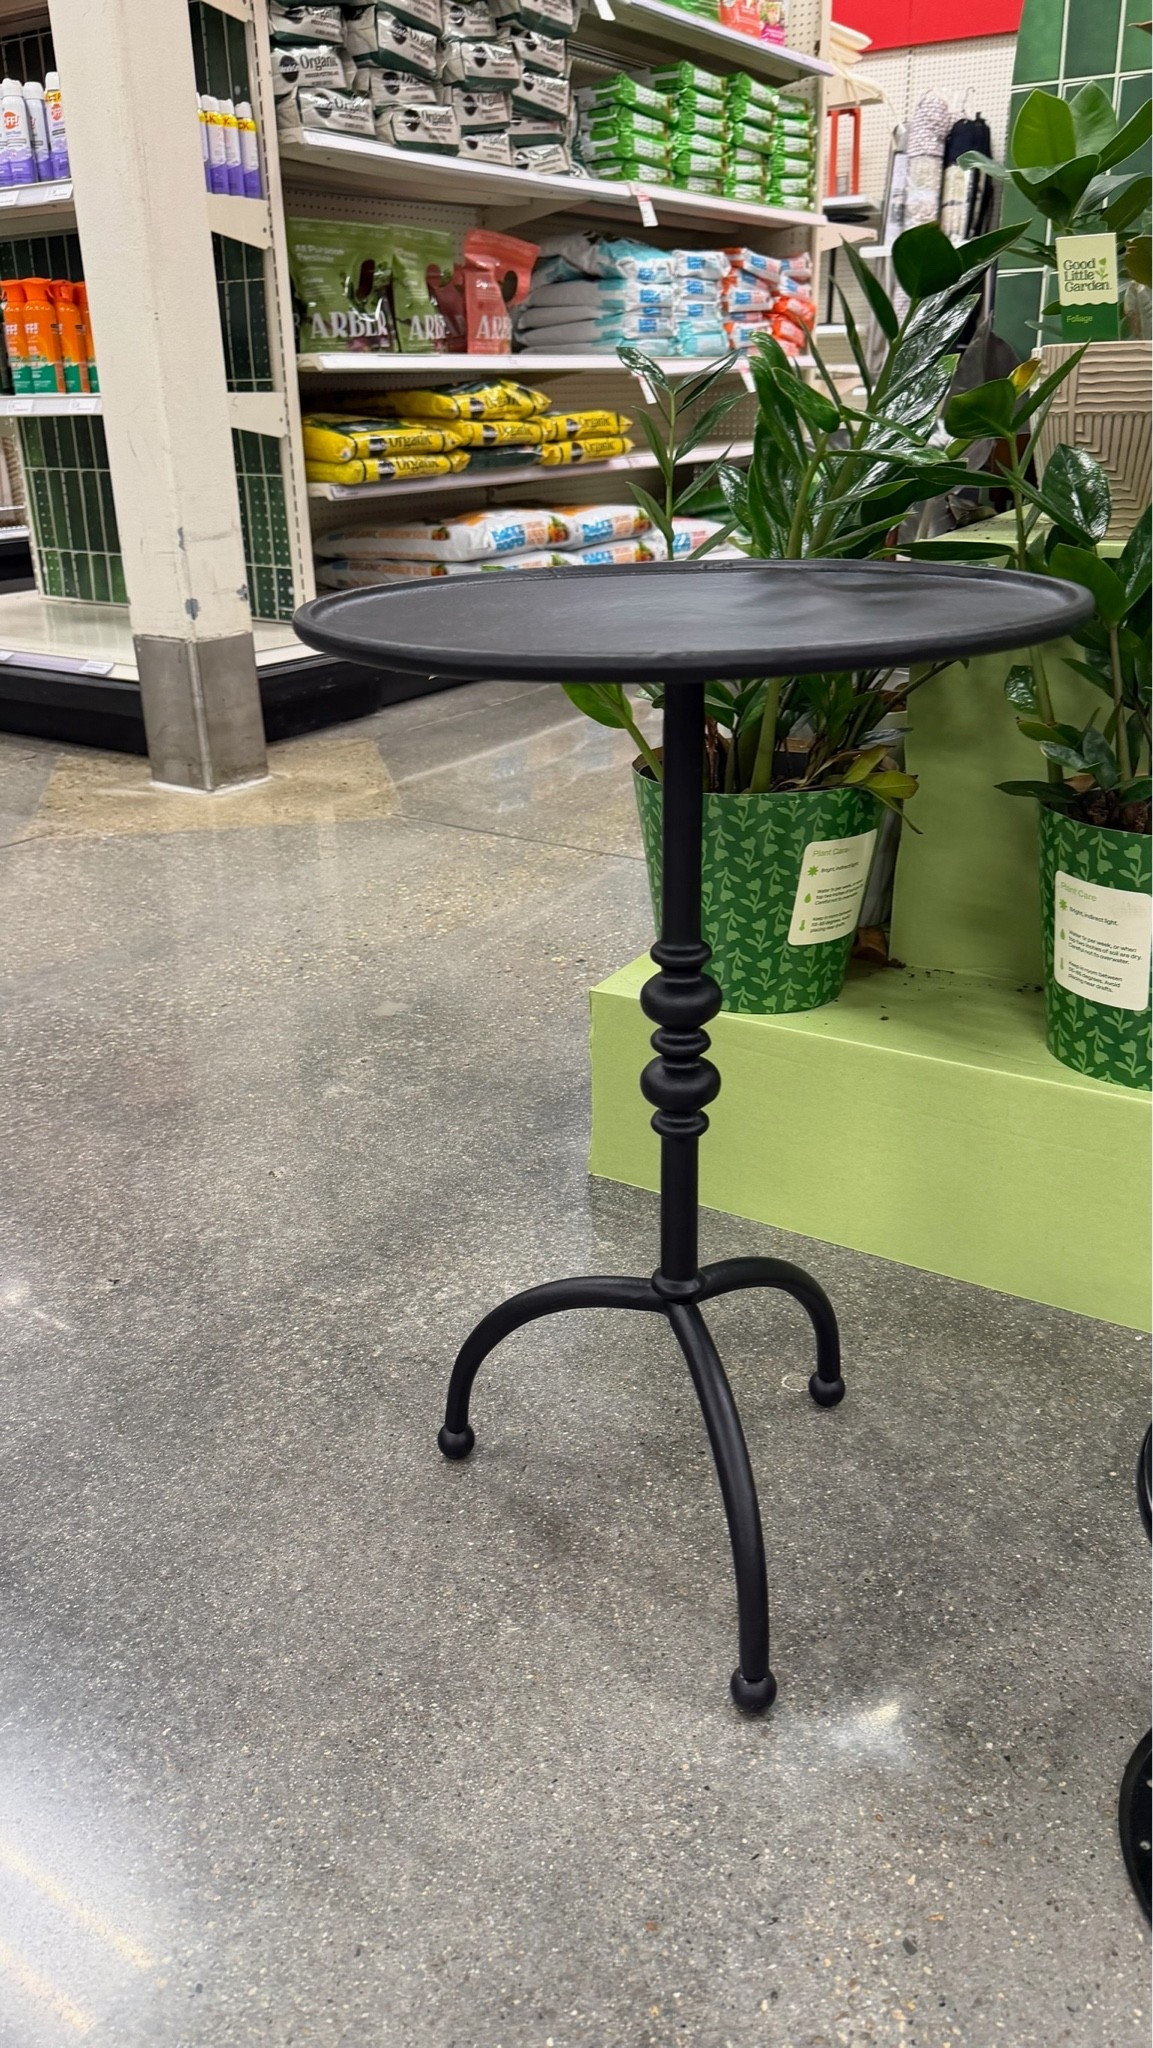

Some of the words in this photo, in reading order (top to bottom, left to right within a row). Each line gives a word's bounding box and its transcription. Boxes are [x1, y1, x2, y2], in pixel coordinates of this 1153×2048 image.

[1063, 258, 1096, 271] Good
[1064, 271, 1095, 282] Little
[311, 311, 390, 340] ARBER
[1066, 314, 1093, 324] Foliage
[388, 434, 433, 449] Organic
[396, 459, 440, 474] Organic
[1078, 889, 1097, 902] Care
